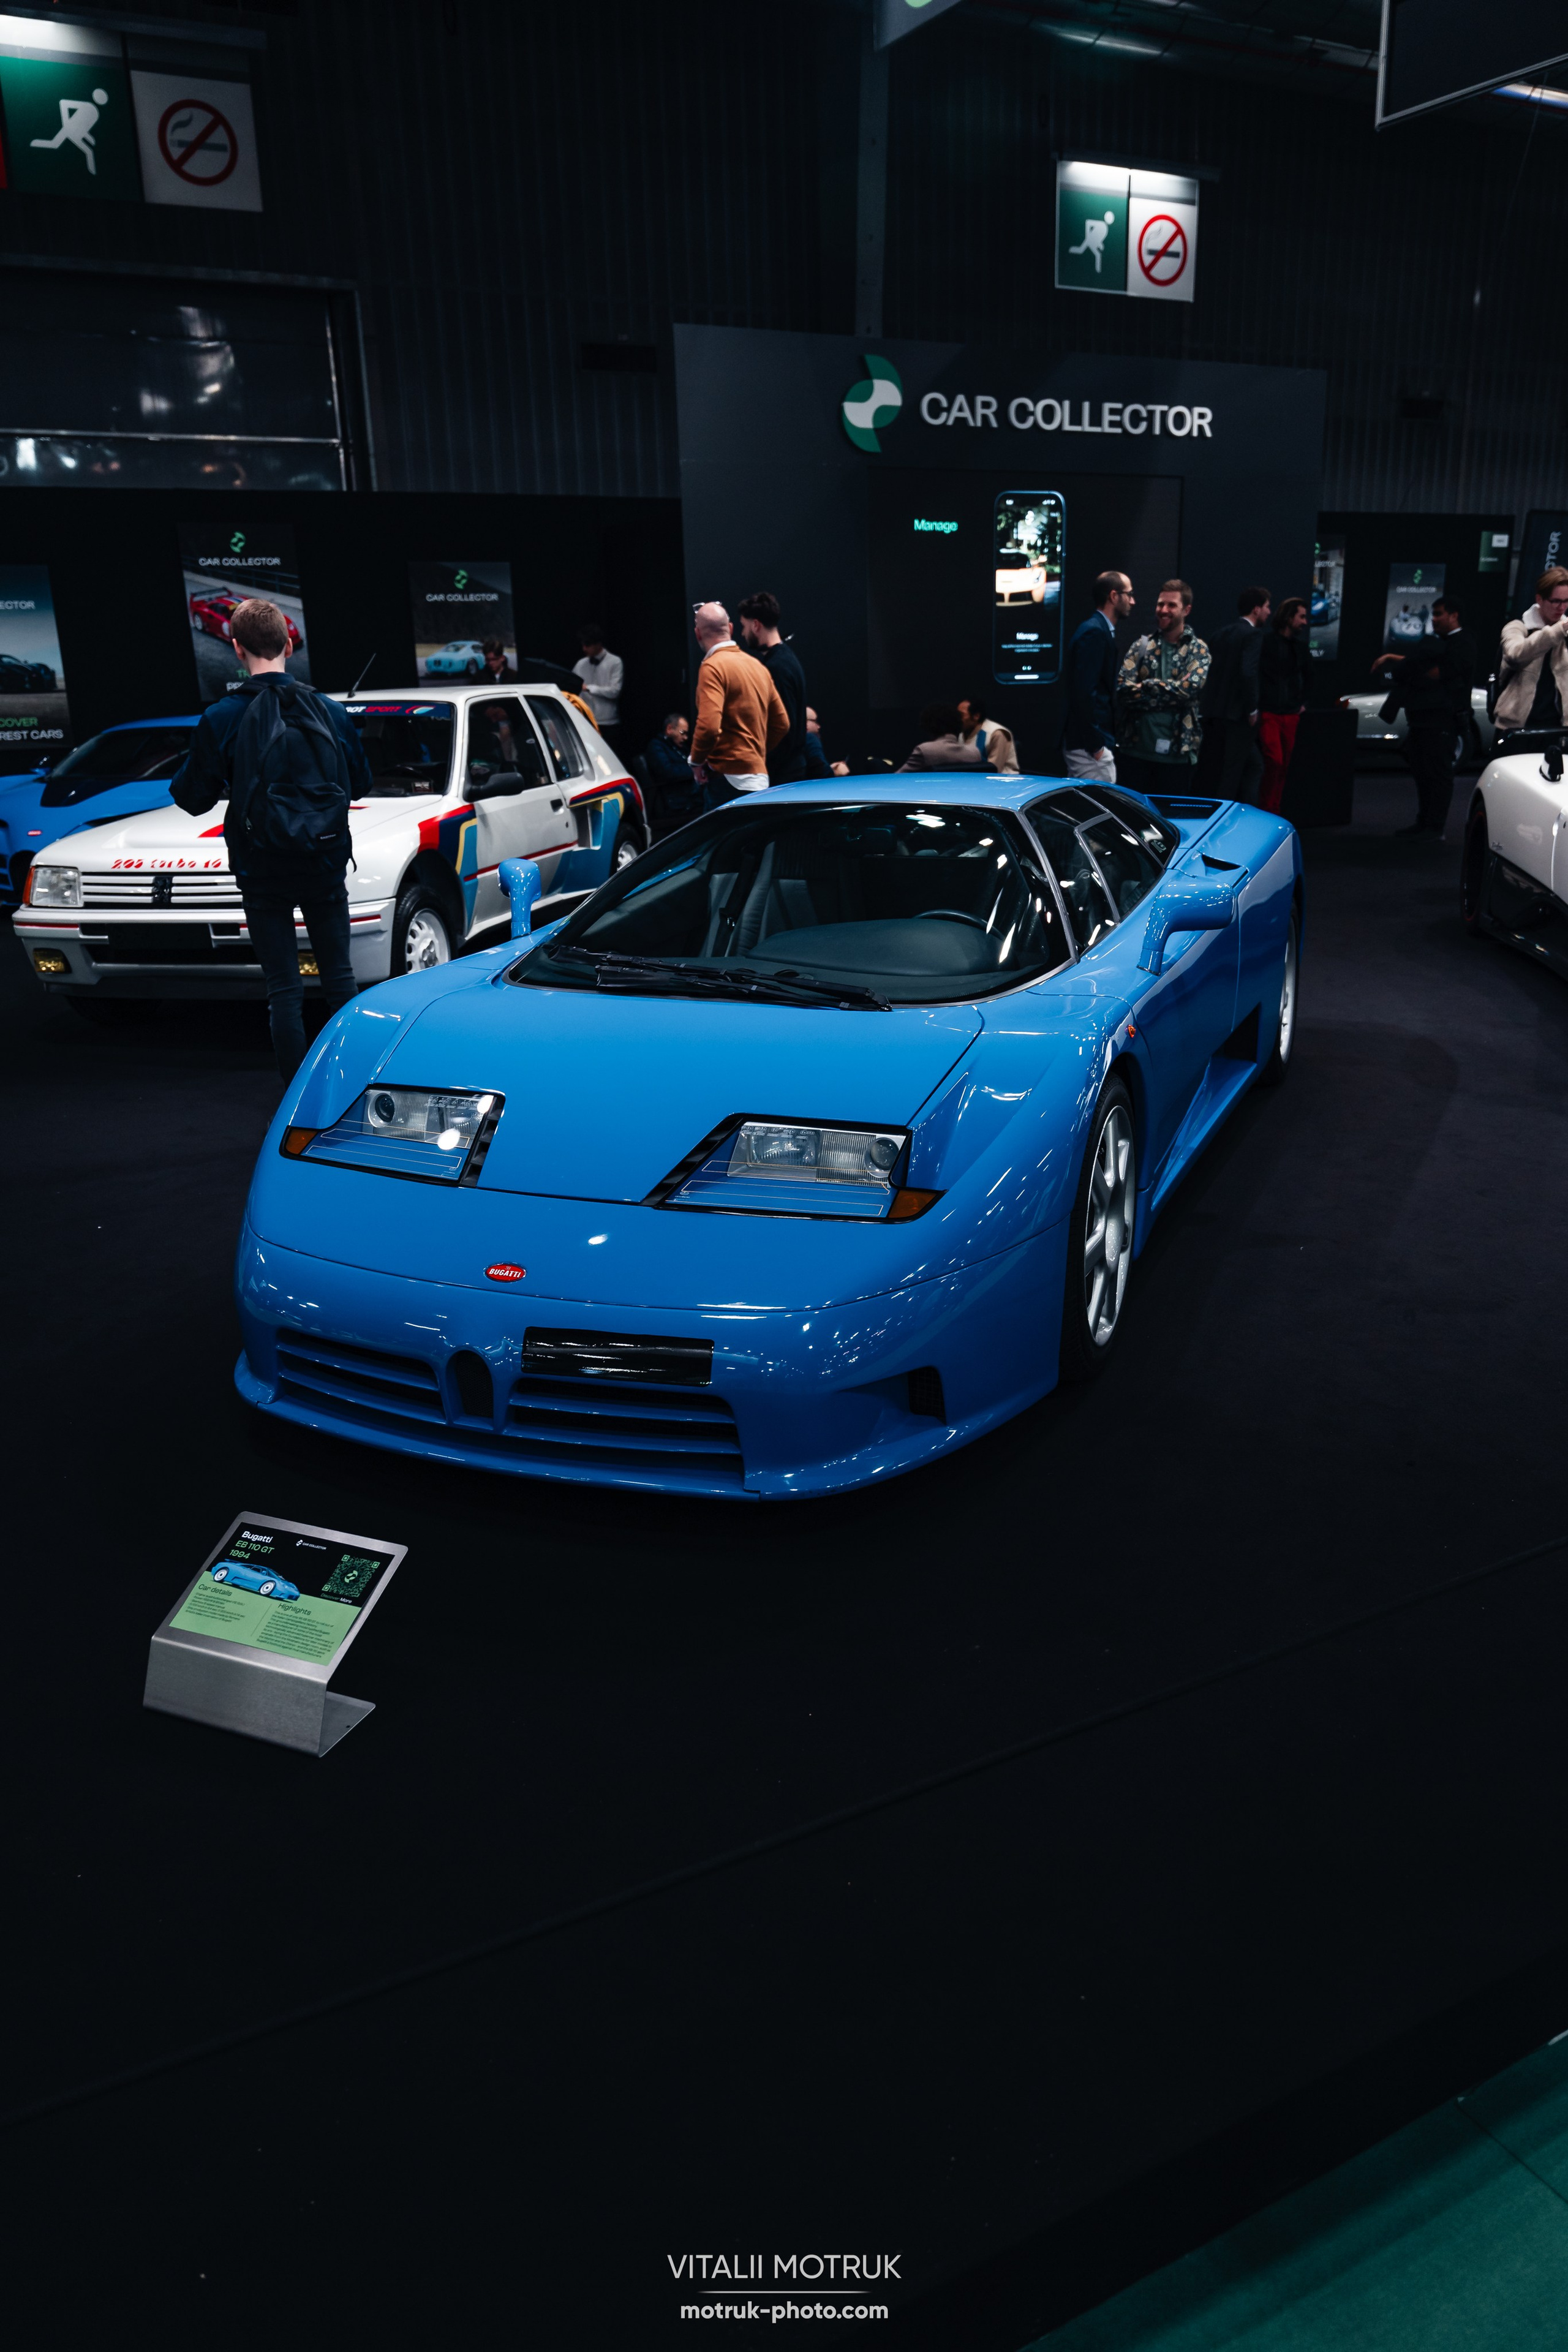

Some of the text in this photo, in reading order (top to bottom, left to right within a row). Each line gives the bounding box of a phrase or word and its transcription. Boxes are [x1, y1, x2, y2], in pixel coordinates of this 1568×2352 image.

[921, 392, 1213, 438] CAR COLLECTOR
[914, 519, 958, 533] Manage
[198, 557, 281, 566] CAR COLLECTOR
[426, 593, 499, 601] CAR COLLECTOR
[31, 729, 64, 739] CARS
[111, 859, 145, 869] 205
[489, 1268, 521, 1278] BUGATTI
[241, 1531, 273, 1543] Bugatti
[230, 1549, 251, 1559] 1994
[211, 1587, 233, 1597] details
[278, 1603, 312, 1616] Highlights
